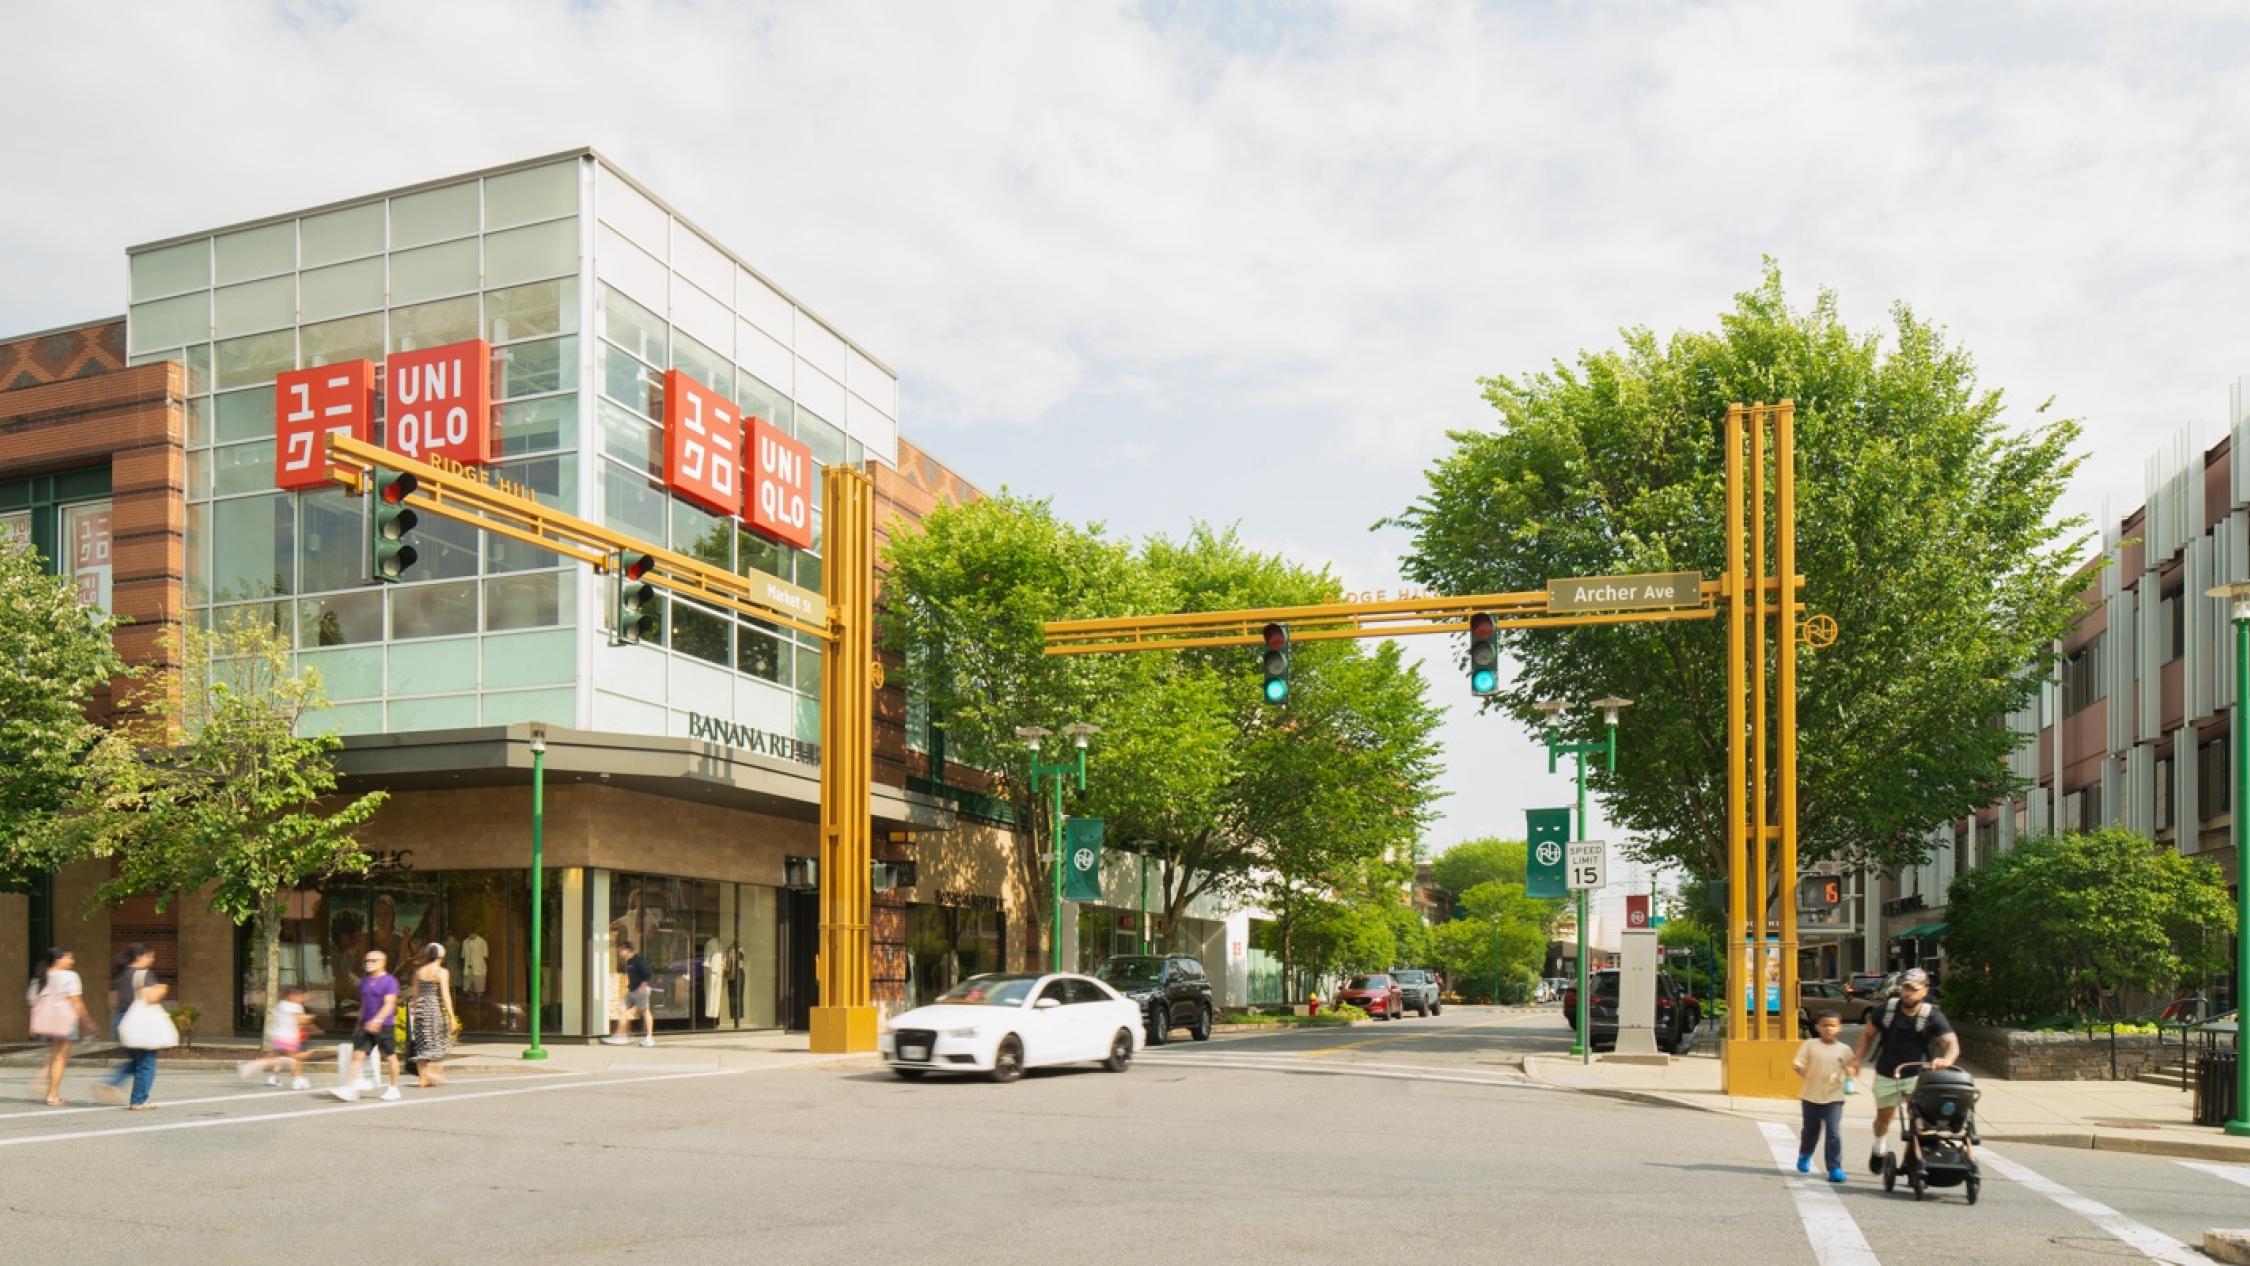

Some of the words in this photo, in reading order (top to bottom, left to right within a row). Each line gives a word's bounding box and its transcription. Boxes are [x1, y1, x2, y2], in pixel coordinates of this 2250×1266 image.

[288, 376, 352, 422] ユニ
[399, 359, 461, 405] UNI
[398, 407, 468, 458] QLO
[684, 391, 733, 450] ユニ
[430, 452, 490, 487] RIDGE
[681, 439, 733, 497] クロ
[761, 435, 802, 489] UNI
[760, 479, 805, 529] QLO
[766, 583, 800, 609] Market
[803, 599, 812, 615] St
[1324, 588, 1387, 605] RDGE
[1574, 584, 1637, 603] Archer
[1643, 585, 1675, 600] Ave
[689, 712, 766, 753] BANANA
[1569, 846, 1602, 856] SPEED
[1572, 856, 1598, 865] LIMIT
[1574, 867, 1598, 884] 15
